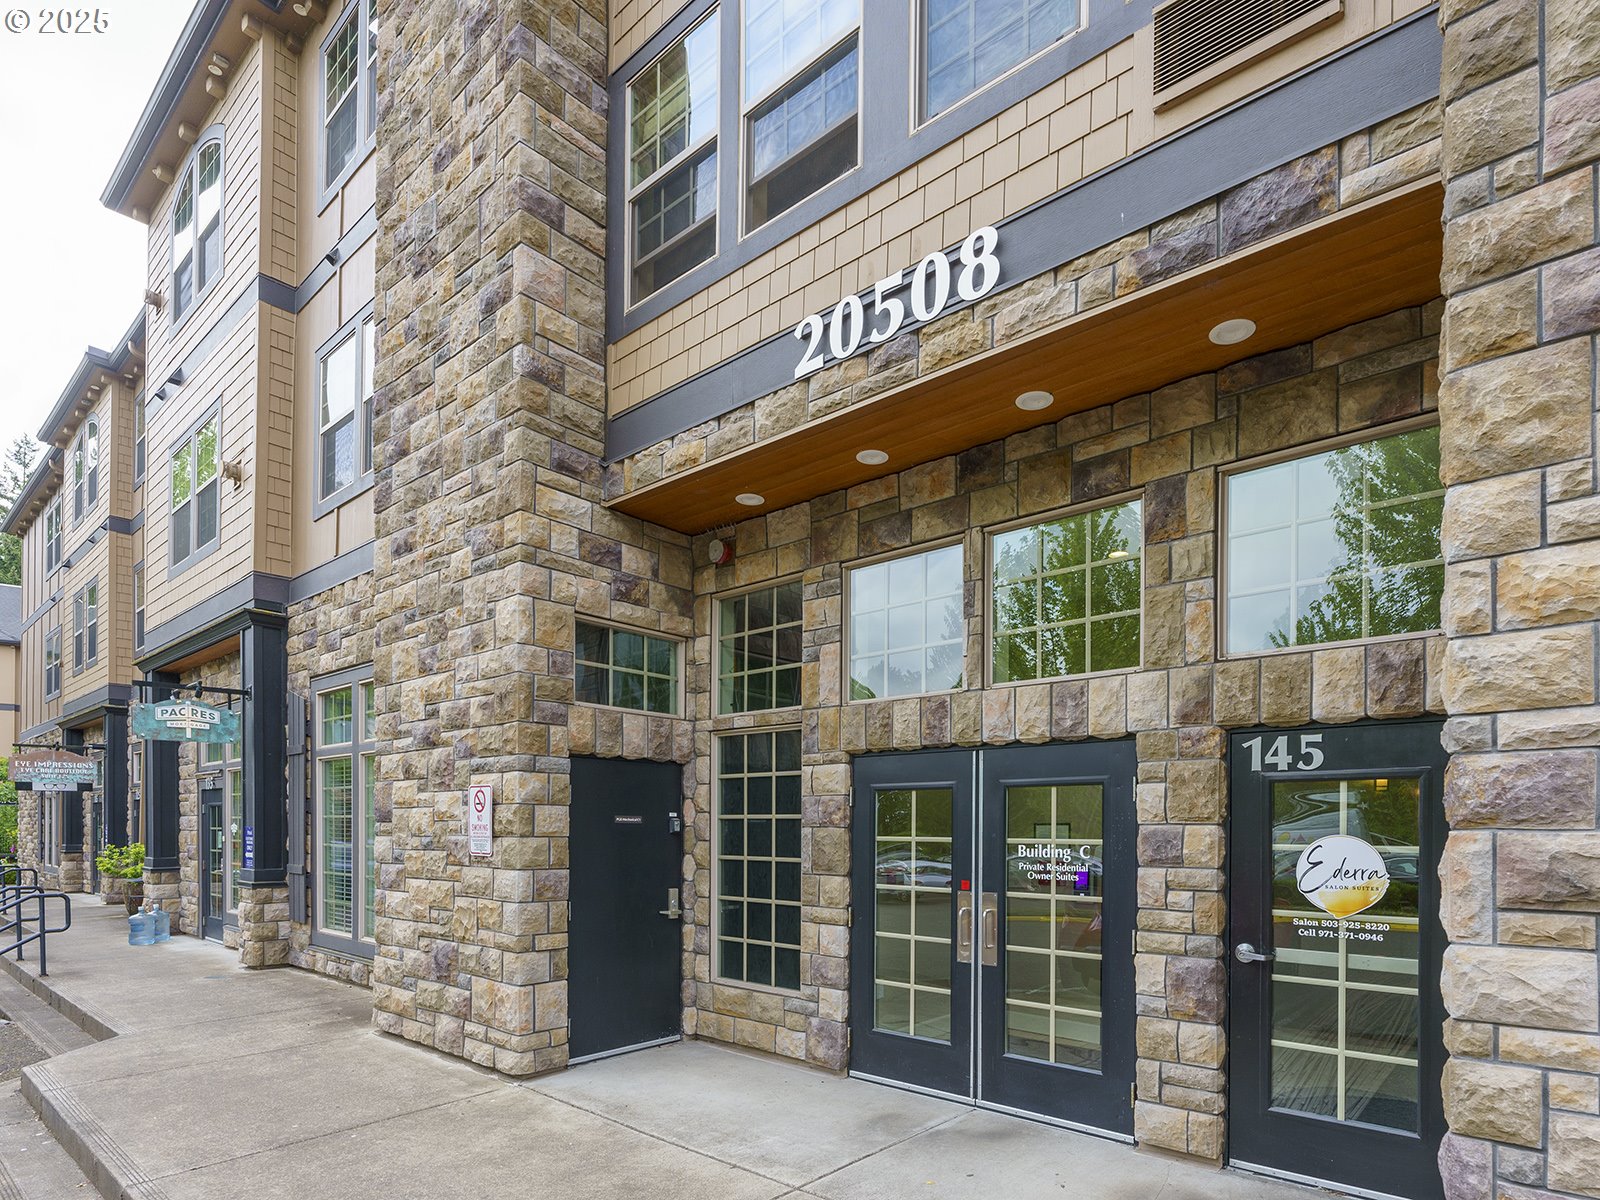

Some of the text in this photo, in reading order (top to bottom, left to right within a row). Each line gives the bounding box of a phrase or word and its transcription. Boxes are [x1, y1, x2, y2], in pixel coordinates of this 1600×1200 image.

[794, 226, 1000, 380] 20508
[1241, 733, 1325, 772] 145
[15, 760, 94, 769] EYE IMPRESSIONS
[471, 823, 489, 832] SMOKING
[1018, 844, 1091, 863] Building C
[1018, 862, 1089, 873] Private Residential
[1299, 844, 1387, 894] Ederra
[1027, 871, 1079, 882] Owner Suites
[1292, 918, 1390, 931] Salon 503-925-8220
[1298, 928, 1384, 942] Cell 971-371-0946
